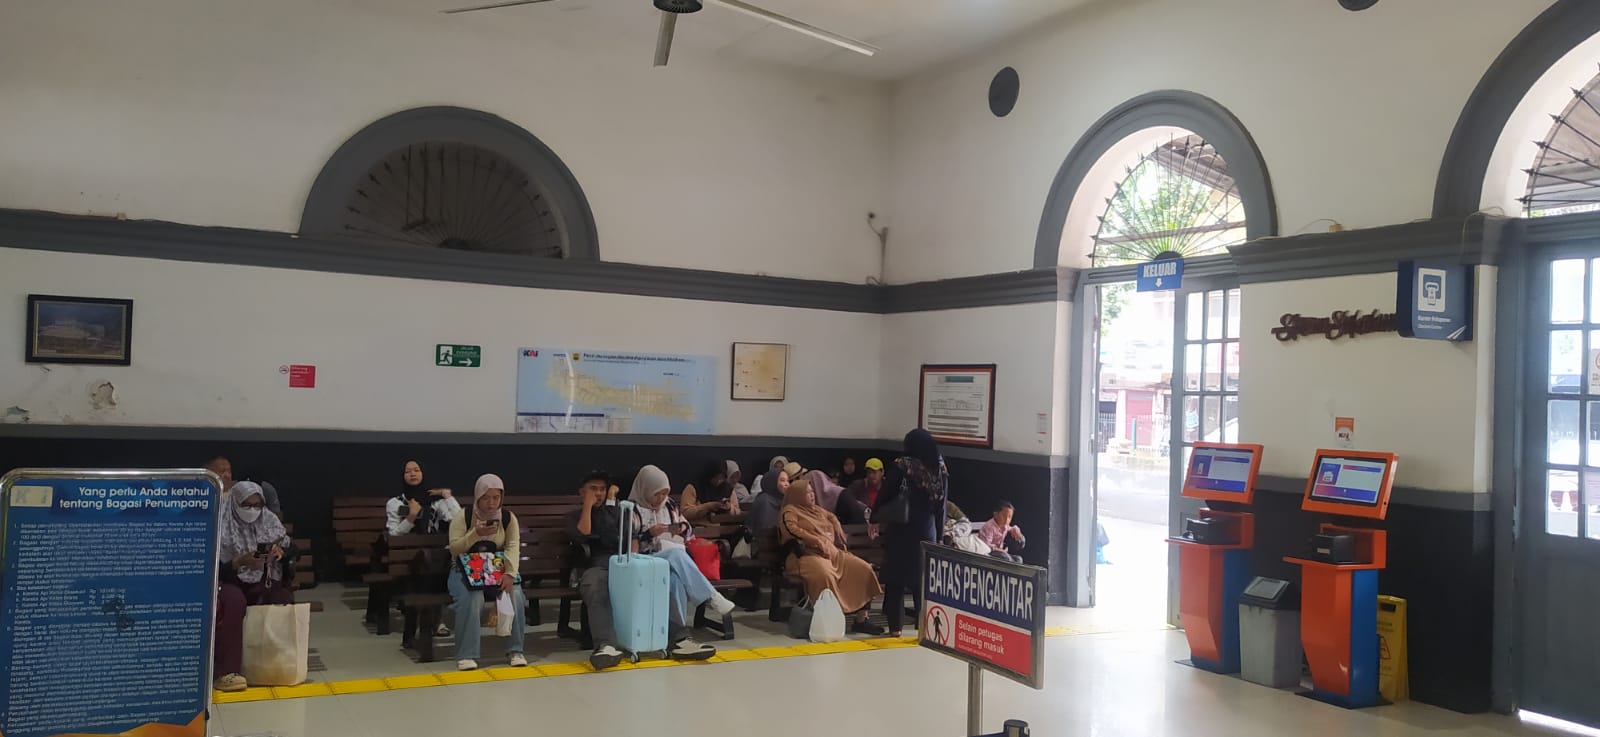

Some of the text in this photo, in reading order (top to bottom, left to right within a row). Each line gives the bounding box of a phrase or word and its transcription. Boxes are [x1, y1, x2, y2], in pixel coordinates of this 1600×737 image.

[1143, 262, 1177, 278] KELUAR
[79, 487, 209, 497] Yang perlu Anda ketahui
[60, 498, 209, 509] tentang Bagasi Penumpang
[929, 558, 1034, 621] BATAS PENGANTAR
[958, 619, 1003, 642] Selain petugas
[958, 631, 983, 650] dilarang
[983, 641, 1005, 655] masuk
